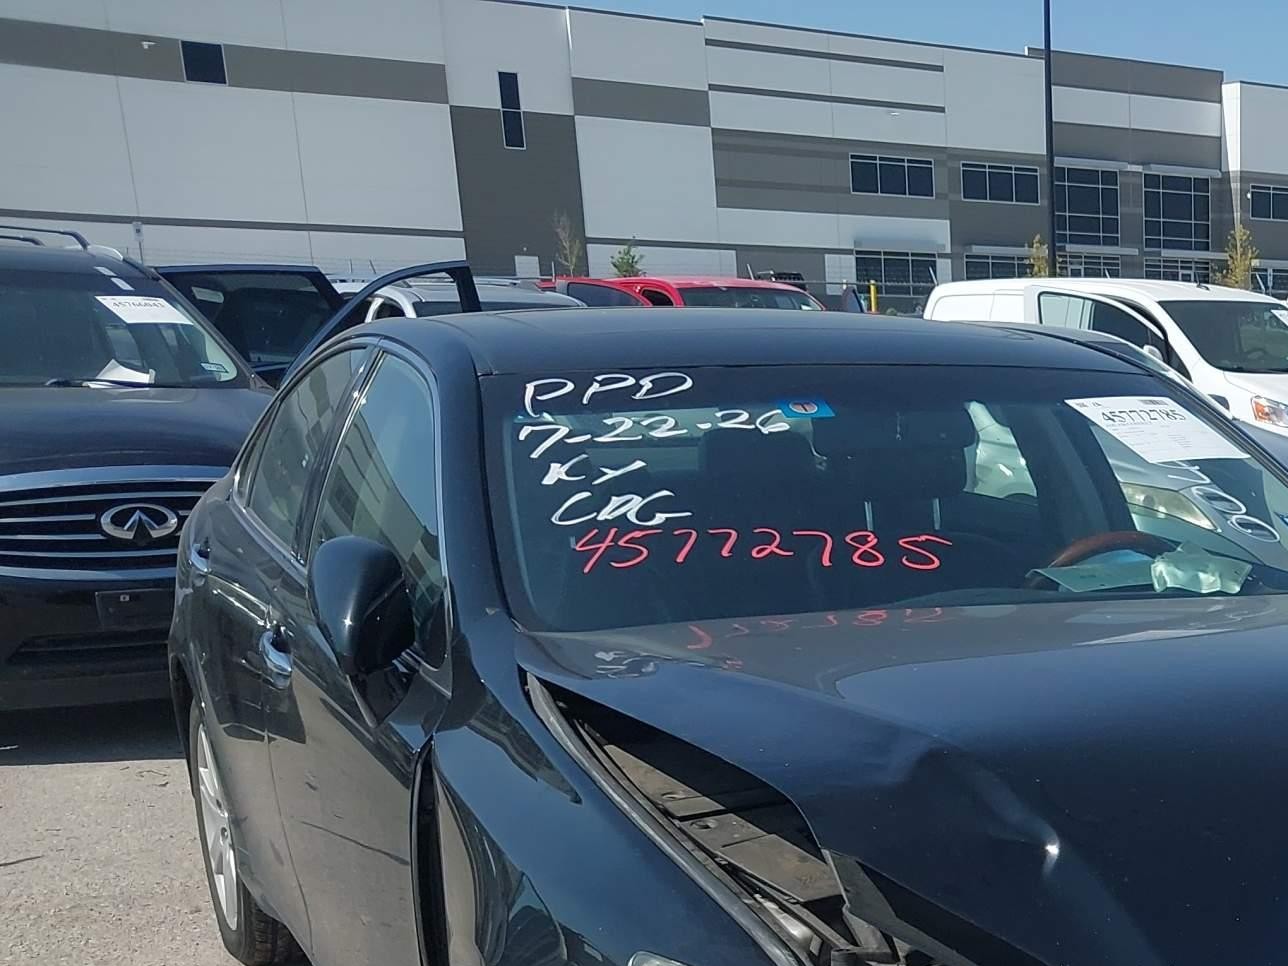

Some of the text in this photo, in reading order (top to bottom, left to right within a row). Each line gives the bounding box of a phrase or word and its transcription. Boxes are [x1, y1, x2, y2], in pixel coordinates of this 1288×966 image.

[525, 372, 693, 418] PPD
[1101, 409, 1187, 424] 45772785
[574, 528, 953, 575] 45772785
